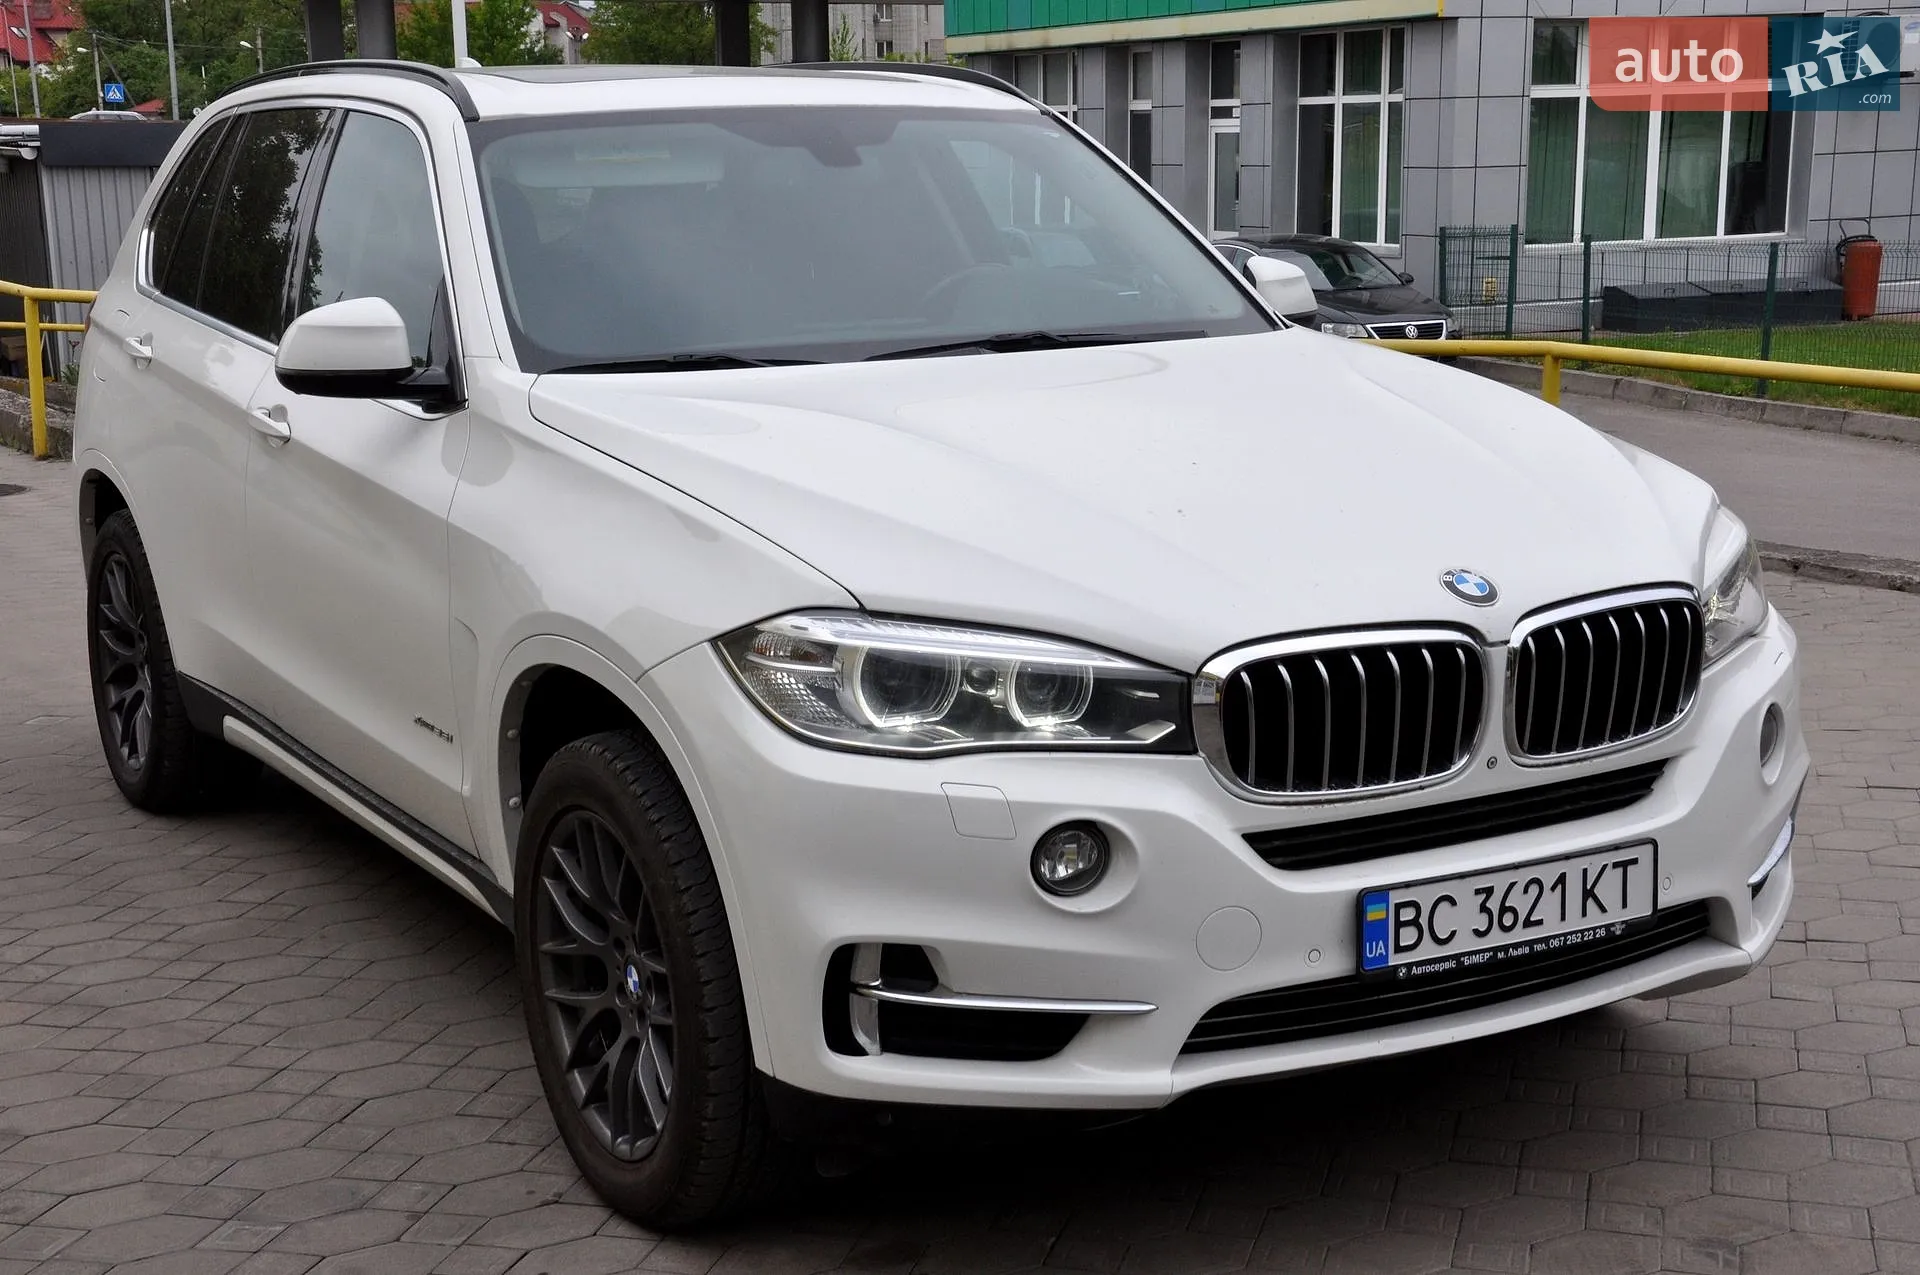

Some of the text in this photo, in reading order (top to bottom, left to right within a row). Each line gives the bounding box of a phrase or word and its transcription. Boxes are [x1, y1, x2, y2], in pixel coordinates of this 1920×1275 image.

[1394, 857, 1640, 954] BC 3621 KT
[1365, 940, 1386, 958] UA
[1411, 960, 1457, 976] Автосервіс
[1508, 946, 1530, 957] Львів
[1549, 937, 1565, 949] 067
[1566, 933, 1582, 945] 252
[1583, 931, 1594, 940] 22
